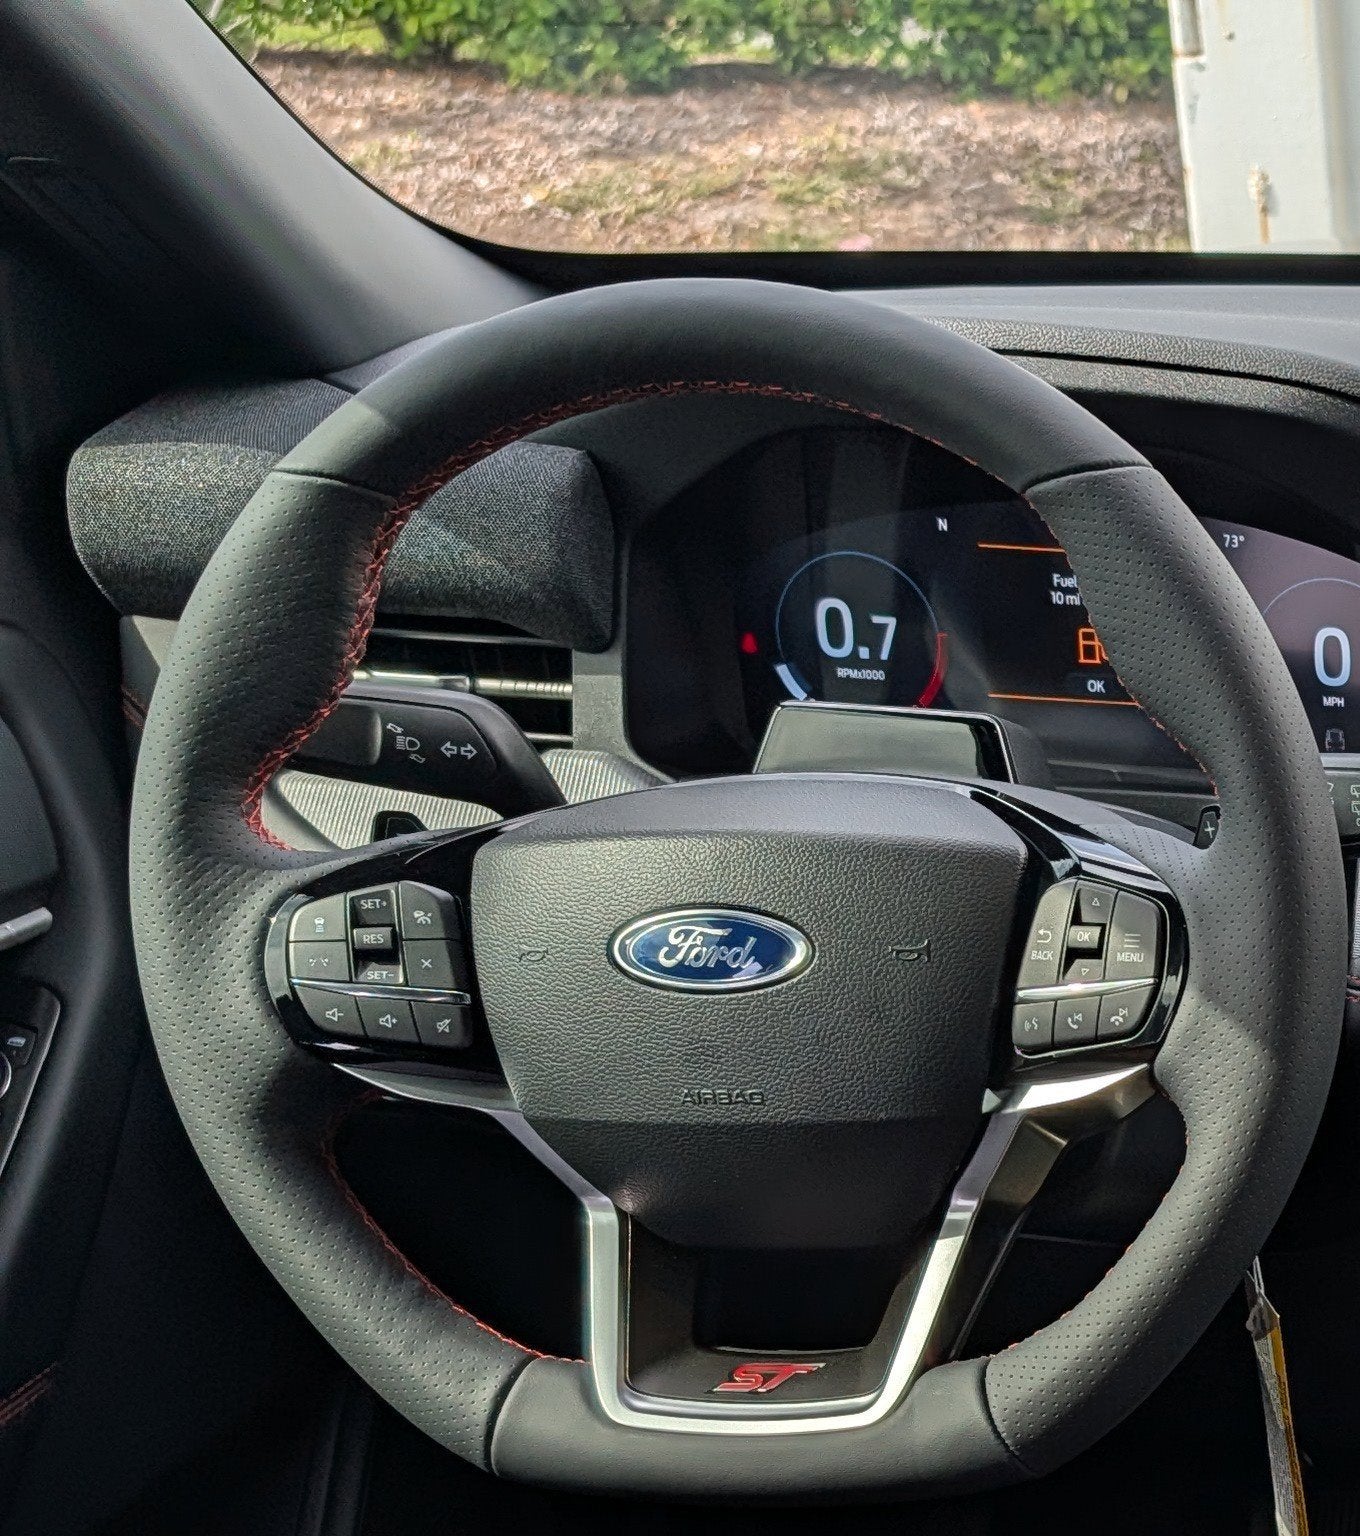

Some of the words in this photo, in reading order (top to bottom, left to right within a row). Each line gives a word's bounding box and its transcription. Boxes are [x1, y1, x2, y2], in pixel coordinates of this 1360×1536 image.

[936, 517, 948, 531] N
[1053, 574, 1077, 588] Fuel
[1051, 591, 1064, 604] 10
[815, 598, 896, 660] 0.7
[1314, 627, 1350, 686] 0
[837, 667, 885, 680] RPMx1000
[1087, 679, 1105, 693] OK
[1323, 696, 1344, 708] MPH
[363, 933, 384, 945] RES
[1077, 932, 1091, 942] OK
[659, 926, 757, 968] Ford
[1031, 950, 1053, 960] BACK
[1117, 952, 1144, 962] MENU
[681, 1089, 765, 1105] AIRBAG
[714, 1362, 824, 1394] ST
